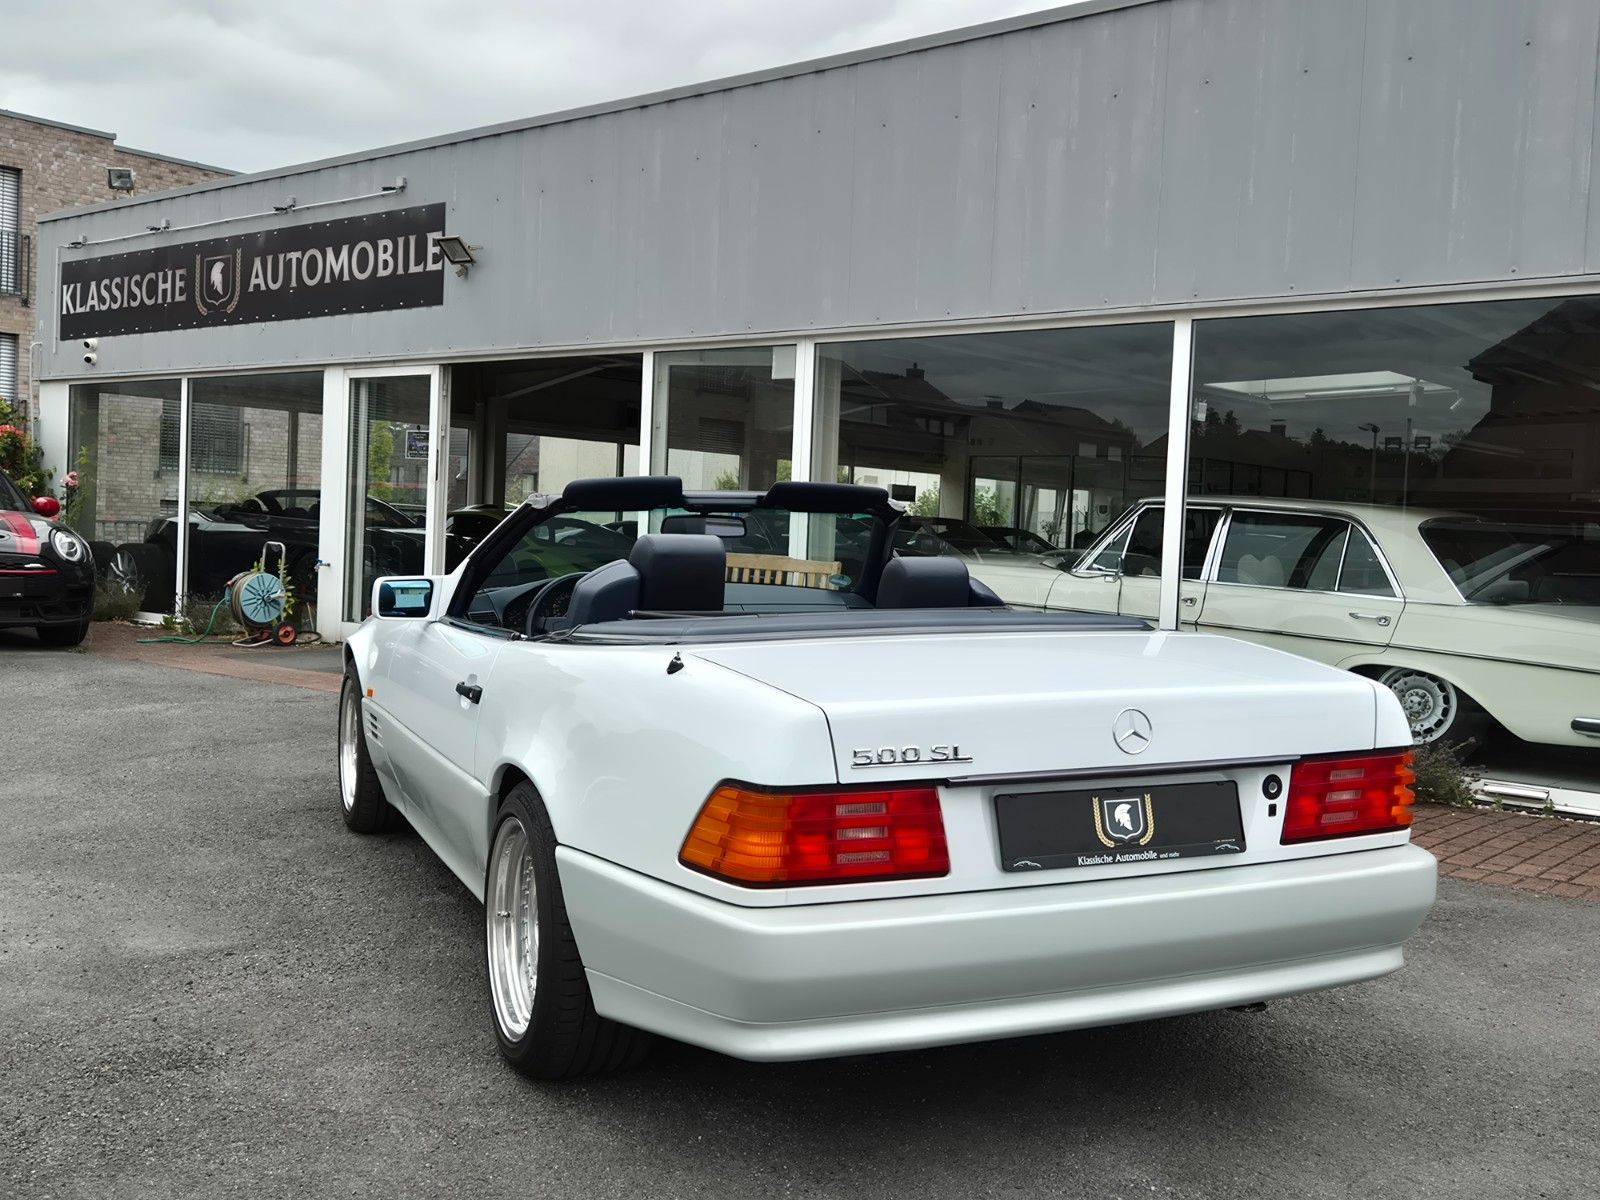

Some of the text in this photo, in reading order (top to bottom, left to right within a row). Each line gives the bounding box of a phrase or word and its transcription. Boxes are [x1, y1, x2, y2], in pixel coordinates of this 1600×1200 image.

[62, 231, 443, 315] KLASSISCHE AUTOMOBILE
[852, 744, 972, 765] 500 SL
[1077, 855, 1113, 866] Klassische
[1115, 850, 1158, 863] Automobile
